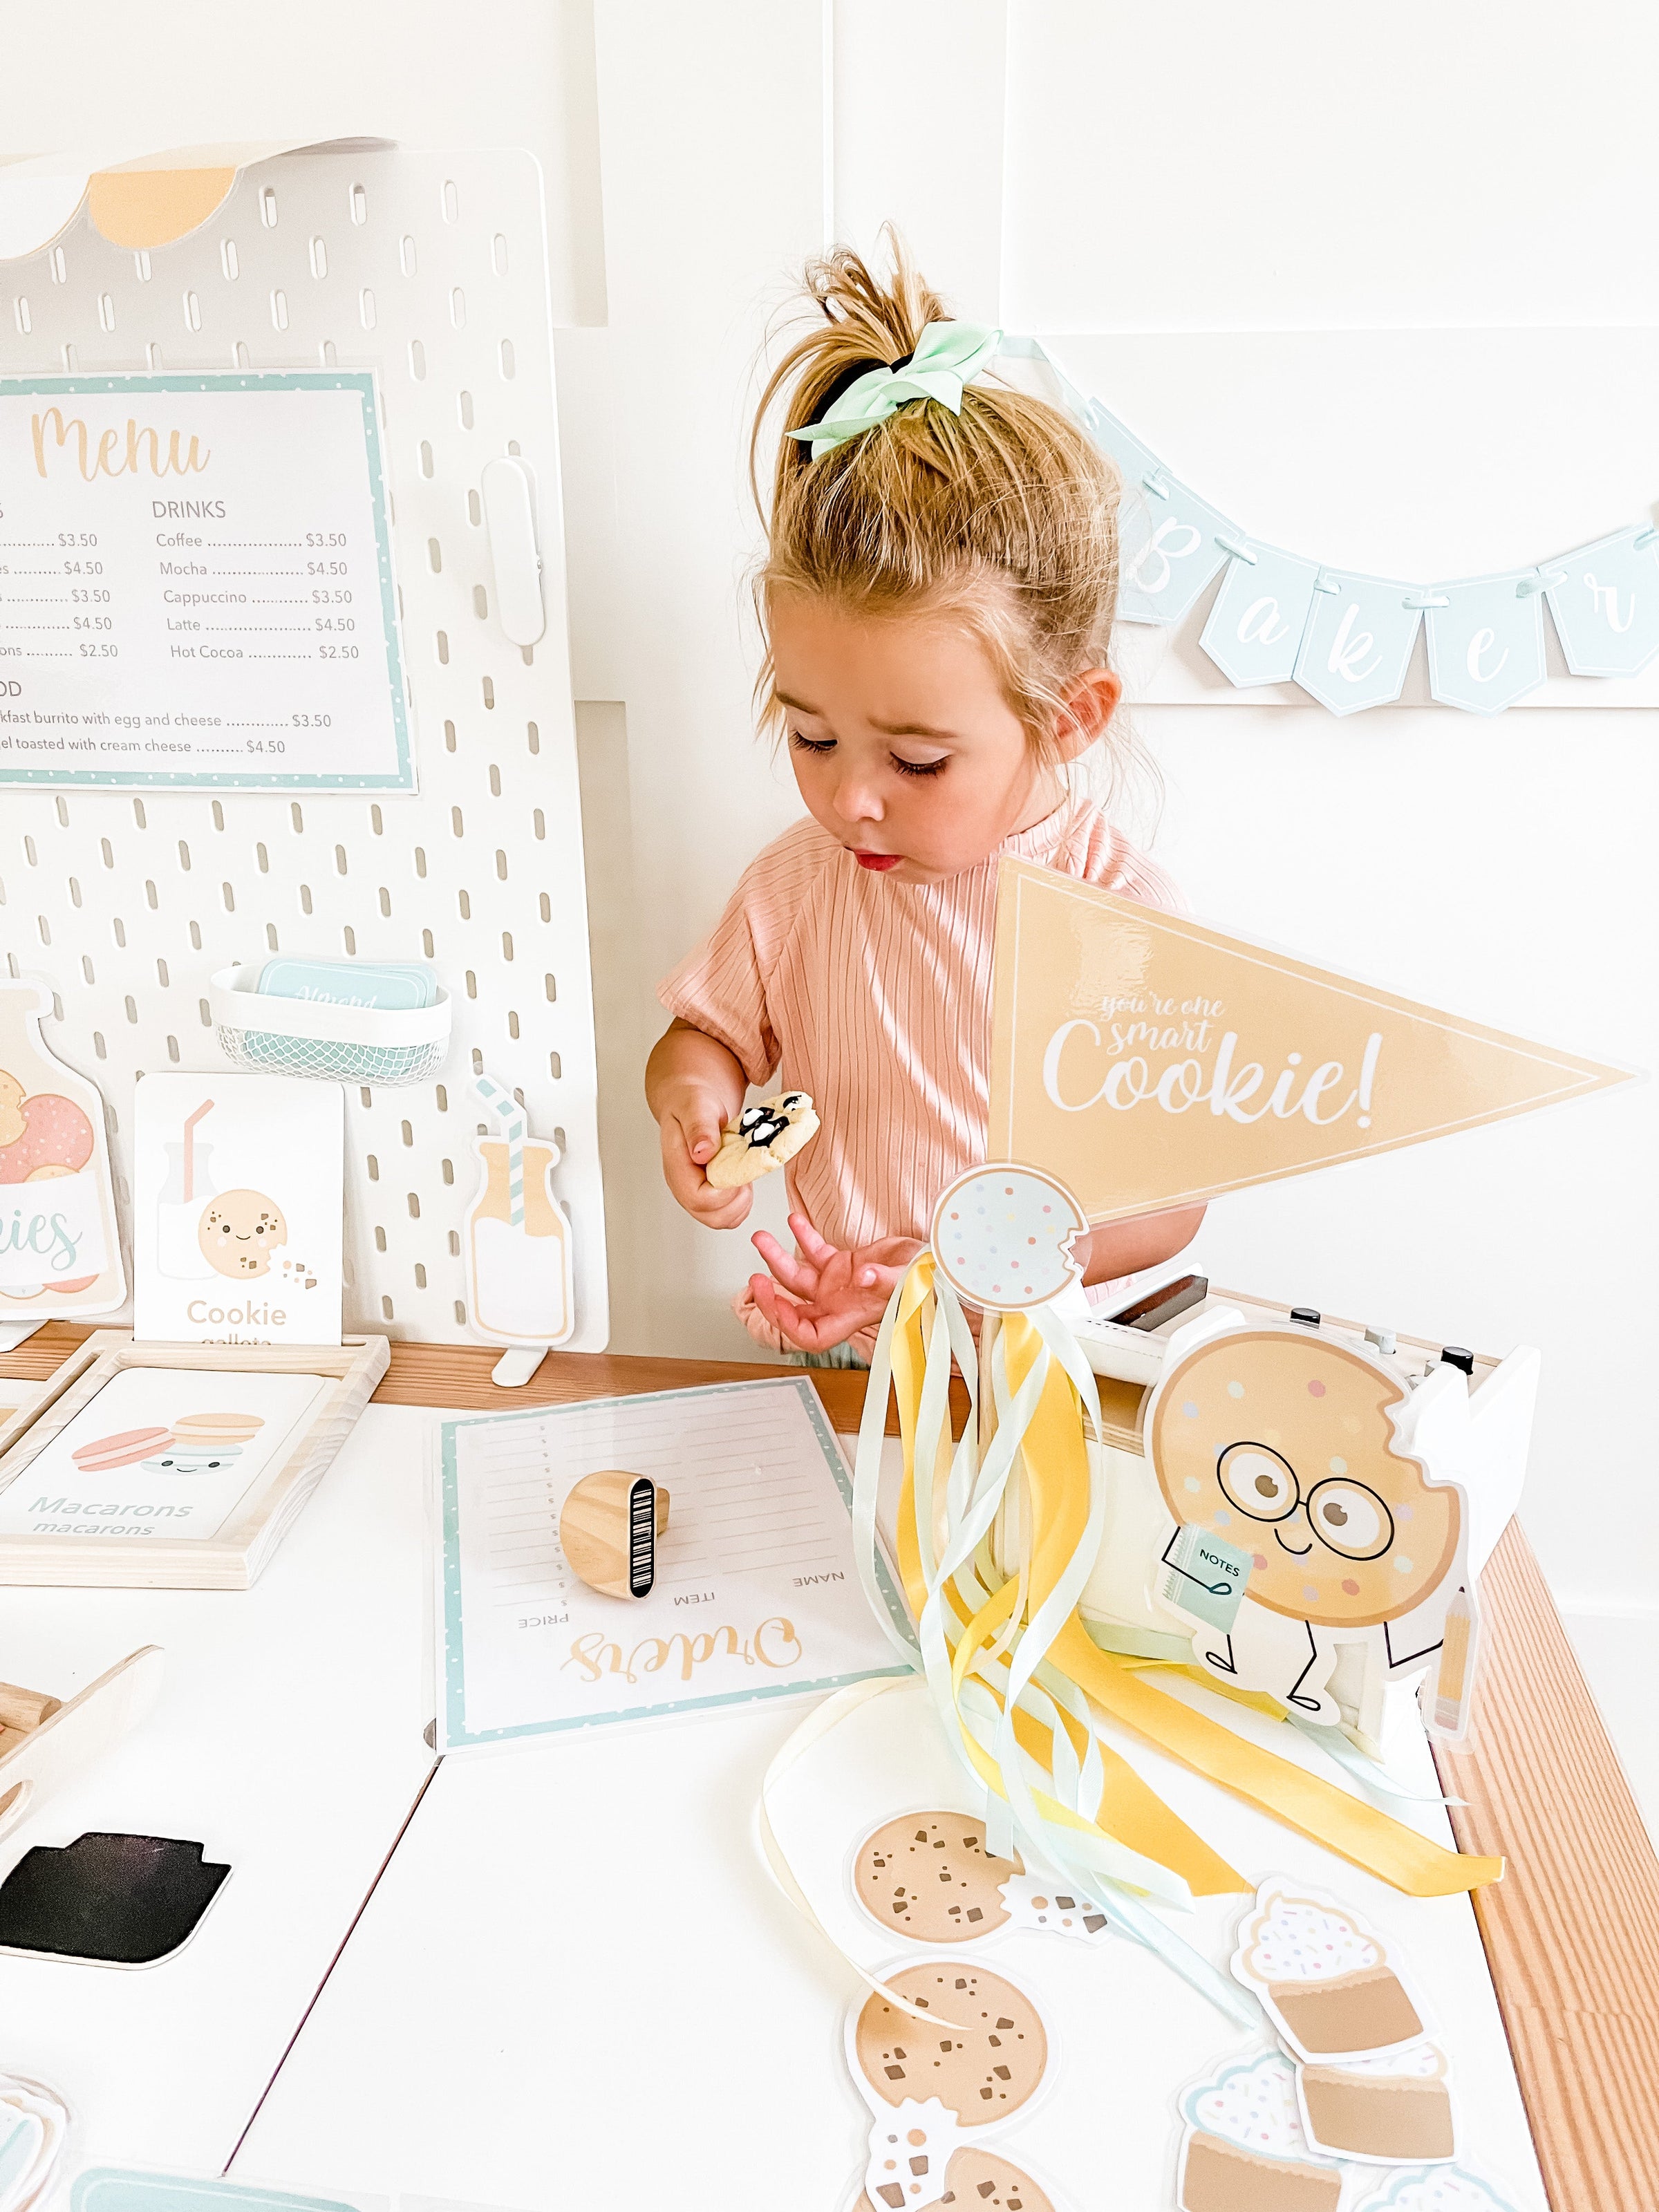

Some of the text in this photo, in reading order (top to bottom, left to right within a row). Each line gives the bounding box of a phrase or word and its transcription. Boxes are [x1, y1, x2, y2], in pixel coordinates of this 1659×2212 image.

[32, 406, 210, 482] Menu
[152, 500, 226, 518] DRINKS
[58, 533, 97, 547] $3.50
[156, 532, 346, 547] Coffee $3.50
[64, 561, 103, 575] $4.50
[160, 562, 348, 575] Mocha $4.50
[71, 589, 111, 603] $3.50
[163, 590, 353, 606] Cappuccino $3.50
[73, 617, 112, 630] $4.50
[167, 618, 355, 631] Latte $4.50
[79, 644, 118, 657] $2.50
[171, 645, 359, 659] Hot Cocoa $2.50
[34, 710, 79, 724] burrito
[82, 711, 111, 725] with
[115, 715, 140, 729] egg
[144, 713, 170, 726] and
[174, 713, 222, 727] cheese
[292, 714, 332, 727] $3.50
[16, 738, 65, 749] toasted
[68, 738, 96, 751] with
[100, 740, 140, 751] cream
[144, 738, 191, 752] cheese
[246, 740, 285, 753] $4.50
[1181, 996, 1226, 1018] one
[1107, 1018, 1215, 1056] smart
[1042, 1018, 1382, 1129] Cookie!
[0, 1210, 83, 1271] ies
[187, 1300, 287, 1326] Cookie
[28, 1496, 194, 1517] Macarons
[32, 1523, 156, 1535] macarons
[1199, 1548, 1240, 1577] NOTES
[793, 1571, 845, 1587] NAME
[674, 1592, 715, 1606] ITEM
[518, 1613, 569, 1629] PRICE
[560, 1617, 803, 1684] Orders
